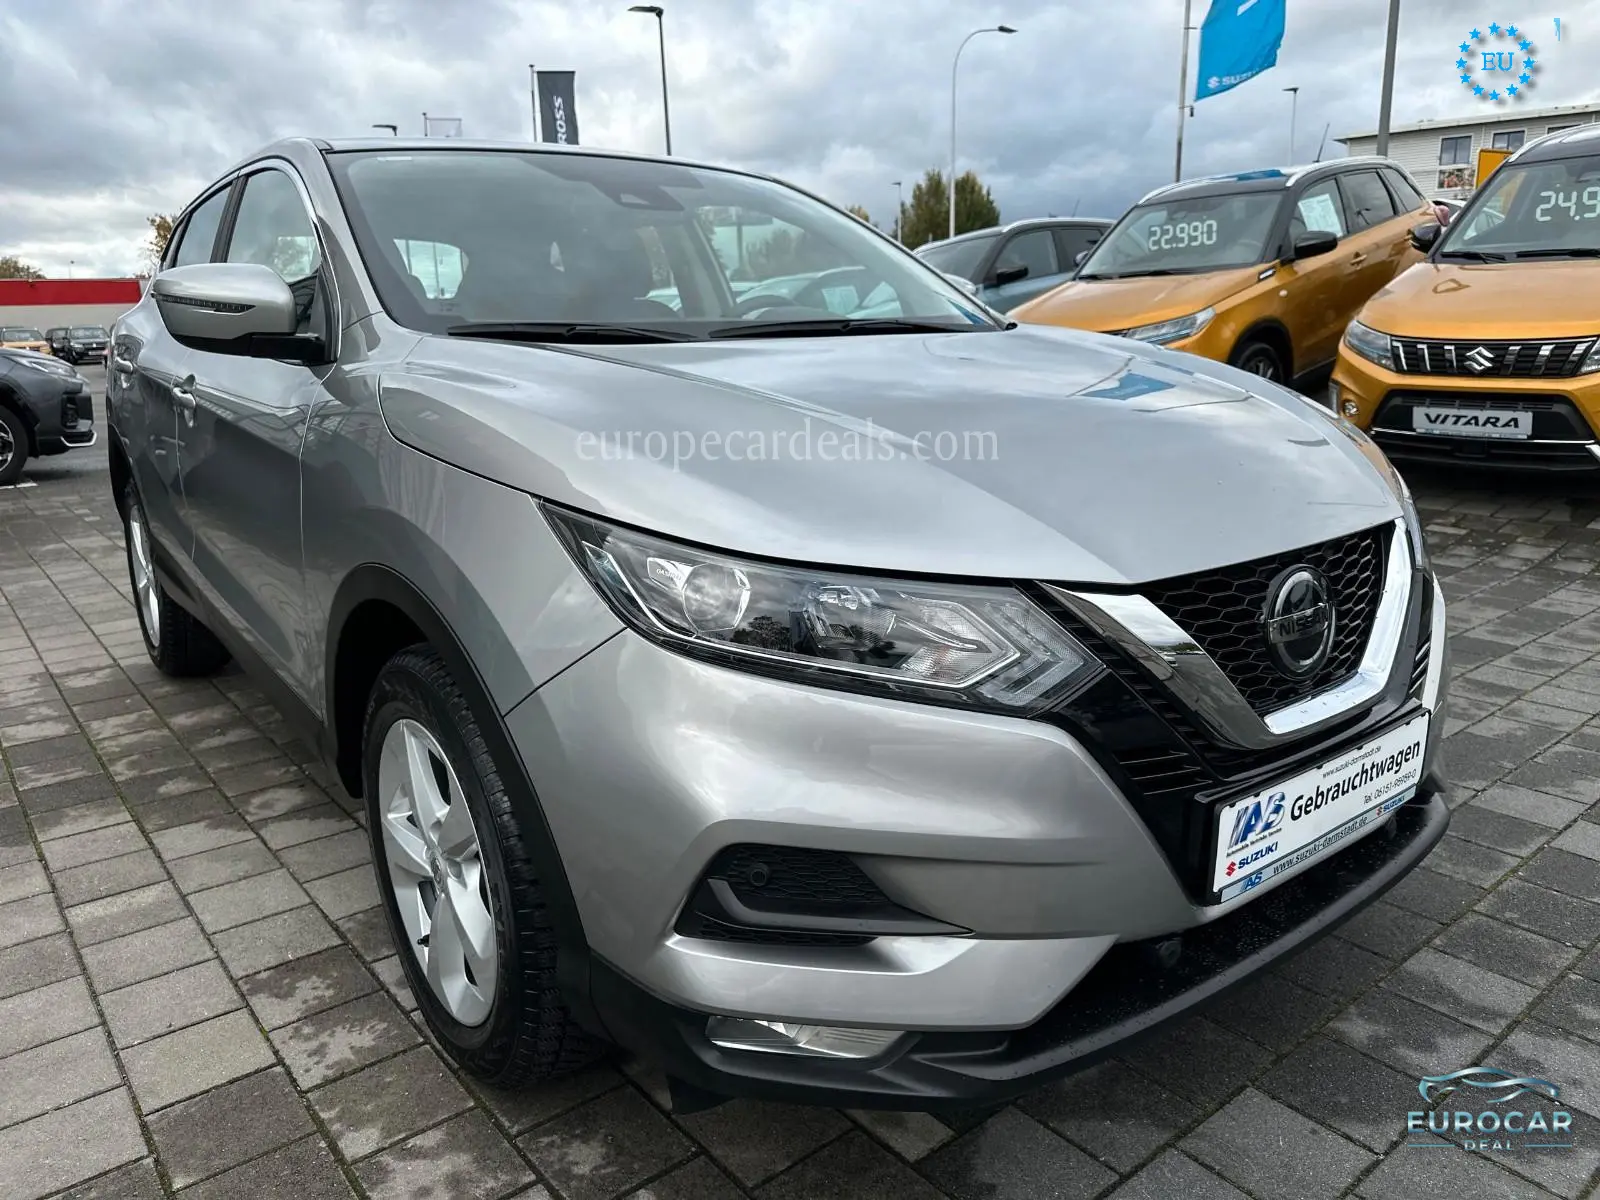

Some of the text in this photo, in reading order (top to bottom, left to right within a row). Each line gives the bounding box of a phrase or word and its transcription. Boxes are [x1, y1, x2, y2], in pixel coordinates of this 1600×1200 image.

[1149, 220, 1217, 250] 22.990
[1424, 413, 1519, 429] VITARA
[1291, 741, 1420, 821] Gebrauchtwagen
[1238, 841, 1278, 869] SUZUKI
[1273, 816, 1368, 875] www.suzuki-darmstadt.de
